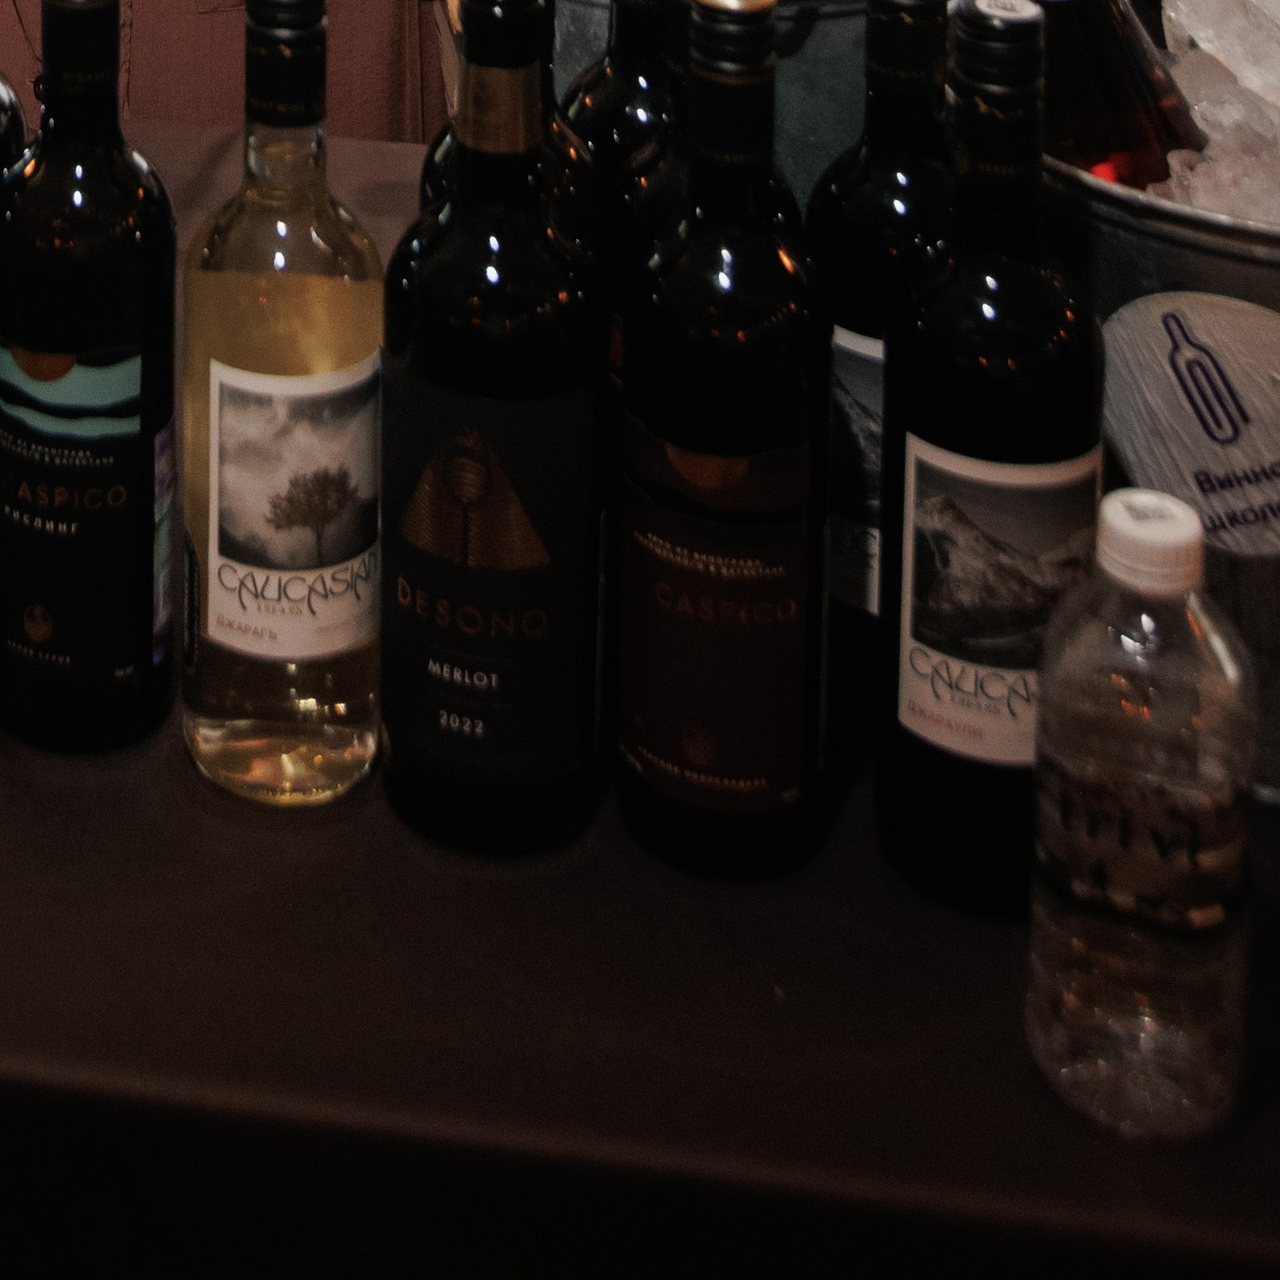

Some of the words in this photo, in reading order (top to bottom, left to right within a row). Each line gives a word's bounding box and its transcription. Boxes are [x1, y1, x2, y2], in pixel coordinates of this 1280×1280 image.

[1204, 502, 1280, 533] школ
[427, 657, 500, 689] MERLOT
[438, 709, 486, 738] 2022
